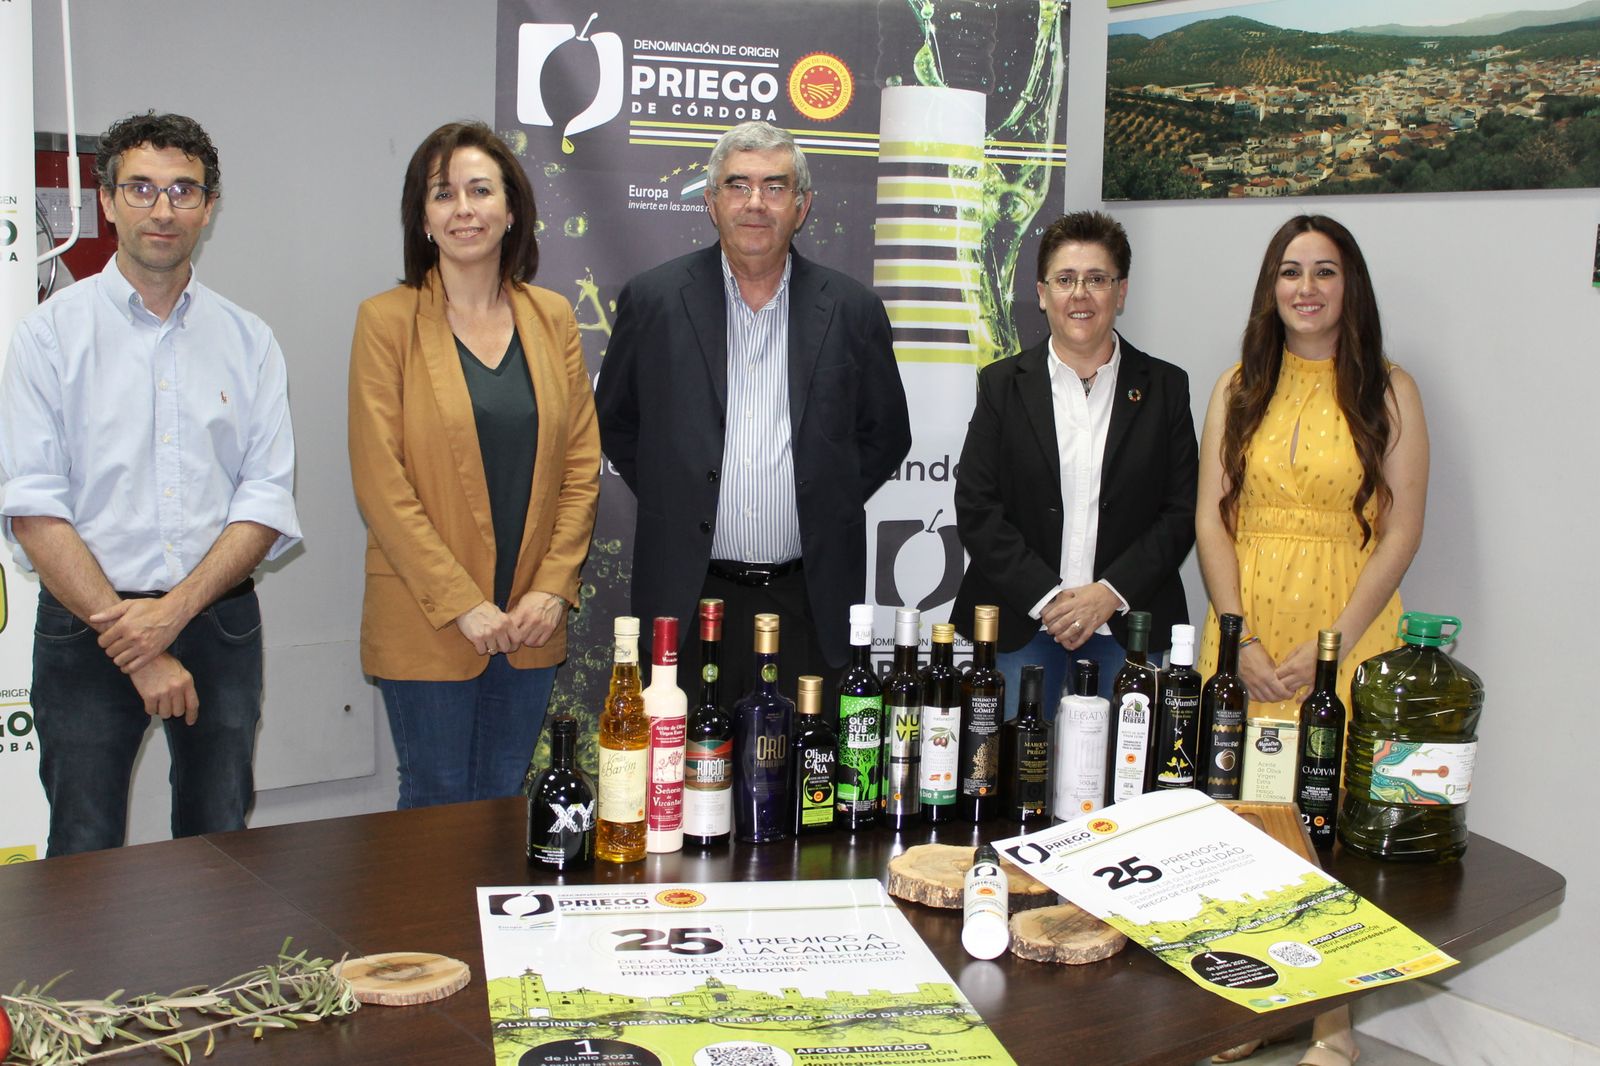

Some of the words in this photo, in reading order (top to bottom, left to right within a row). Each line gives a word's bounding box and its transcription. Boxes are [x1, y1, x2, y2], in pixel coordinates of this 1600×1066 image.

[634, 39, 720, 54] DENOMINACIÓN
[722, 45, 737, 56] DE
[739, 46, 779, 58] ORIGEN
[631, 65, 779, 104] PRIEGO
[631, 102, 657, 114] DE
[672, 102, 777, 121] CÓRDOBA
[628, 184, 669, 201] Europa
[628, 200, 657, 210] invierte
[658, 203, 668, 211] en
[669, 201, 680, 211] las
[681, 205, 704, 213] zonas
[0, 688, 31, 698] RIGEN
[896, 714, 919, 727] NU
[1122, 716, 1146, 725] RIBERA
[1123, 710, 1146, 718] FUENTE
[848, 716, 875, 726] OLEO
[848, 725, 867, 734] SUB
[896, 730, 919, 742] VE
[757, 734, 786, 760] ORO
[922, 790, 932, 799] bio
[1044, 831, 1091, 851] PRIEGO
[1159, 843, 1219, 866] PREMIOS
[1219, 841, 1231, 849] A
[1170, 864, 1192, 875] LA
[1189, 846, 1246, 868] CALIDAD
[1092, 855, 1163, 890] 25
[558, 897, 649, 908] PRIEGO
[611, 927, 724, 956] 25
[738, 934, 859, 945] PREMIOS
[867, 933, 884, 941] A
[743, 947, 776, 955] LA
[783, 941, 901, 955] CALIDAD
[1204, 953, 1228, 965] 1
[719, 966, 808, 975] CÓRDOBA
[497, 1019, 597, 1028] ALMEDINILLA
[608, 1017, 697, 1027] CARCABUEY
[708, 1016, 770, 1024] FUENTE
[823, 1012, 878, 1021] PRIEGO
[880, 1010, 898, 1018] DE
[903, 1007, 971, 1017] CÓRDOBA
[575, 1040, 600, 1055] 1
[854, 1043, 928, 1053] LIMITADO
[564, 1053, 600, 1062] junio
[602, 1053, 635, 1061] 2022
[799, 1053, 854, 1061] PREVIA
[859, 1049, 958, 1060] INSCRIPCIÓN
